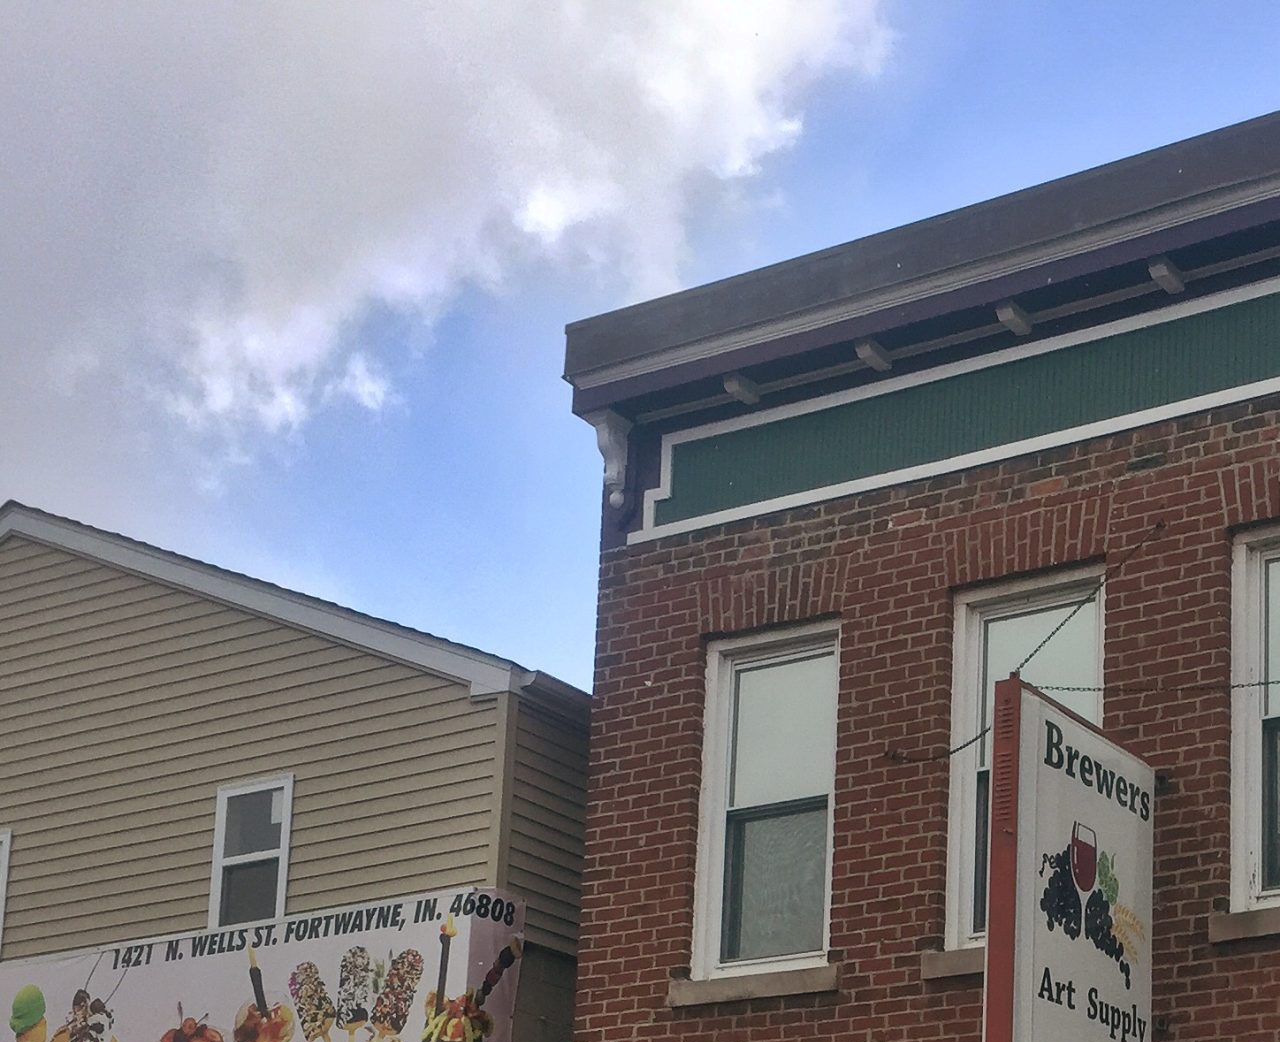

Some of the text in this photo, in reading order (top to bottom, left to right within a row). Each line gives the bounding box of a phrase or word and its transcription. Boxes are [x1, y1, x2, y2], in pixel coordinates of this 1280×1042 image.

[1044, 719, 1150, 822] Brewers
[112, 892, 516, 970] 1421 N. WELLS ST. FORTWAYNE, IN. 46808
[1038, 966, 1076, 1010] Art
